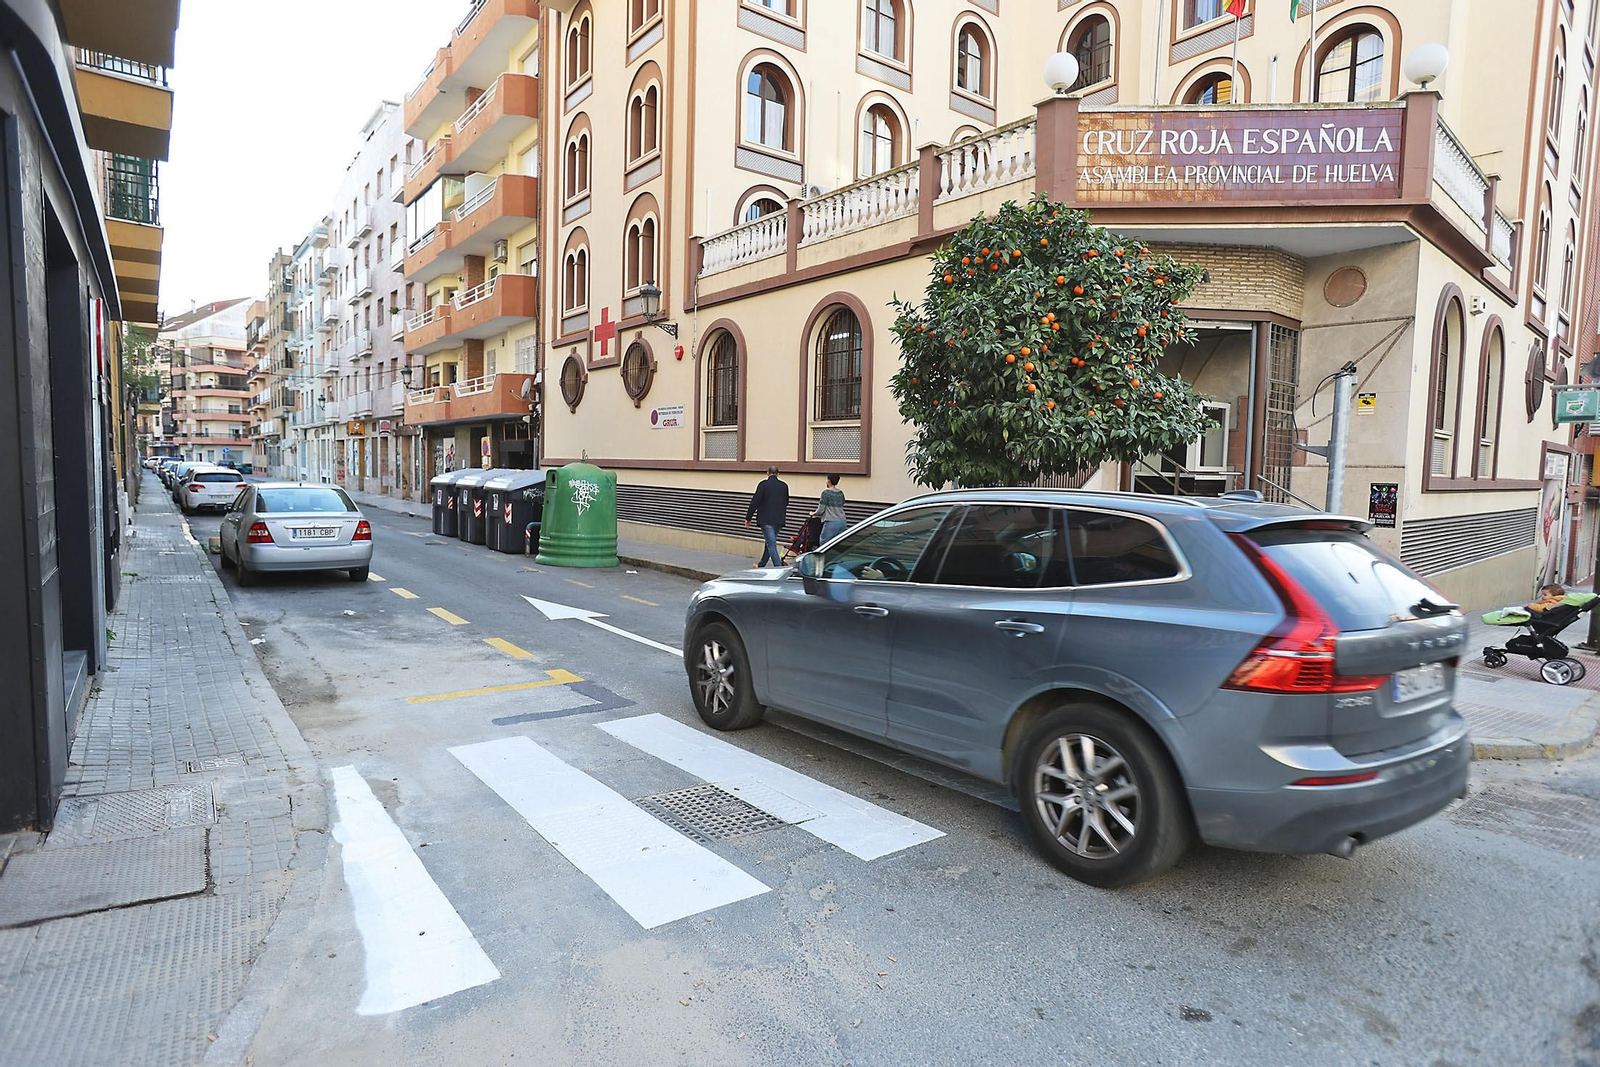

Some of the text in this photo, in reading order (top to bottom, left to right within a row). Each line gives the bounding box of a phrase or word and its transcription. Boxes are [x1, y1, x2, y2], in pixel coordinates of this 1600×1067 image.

[1082, 122, 1394, 155] CRUZ ROJA ESPAÑOLA
[1078, 163, 1395, 184] ASAMBLEA PROVINCIAL DE HUELVA
